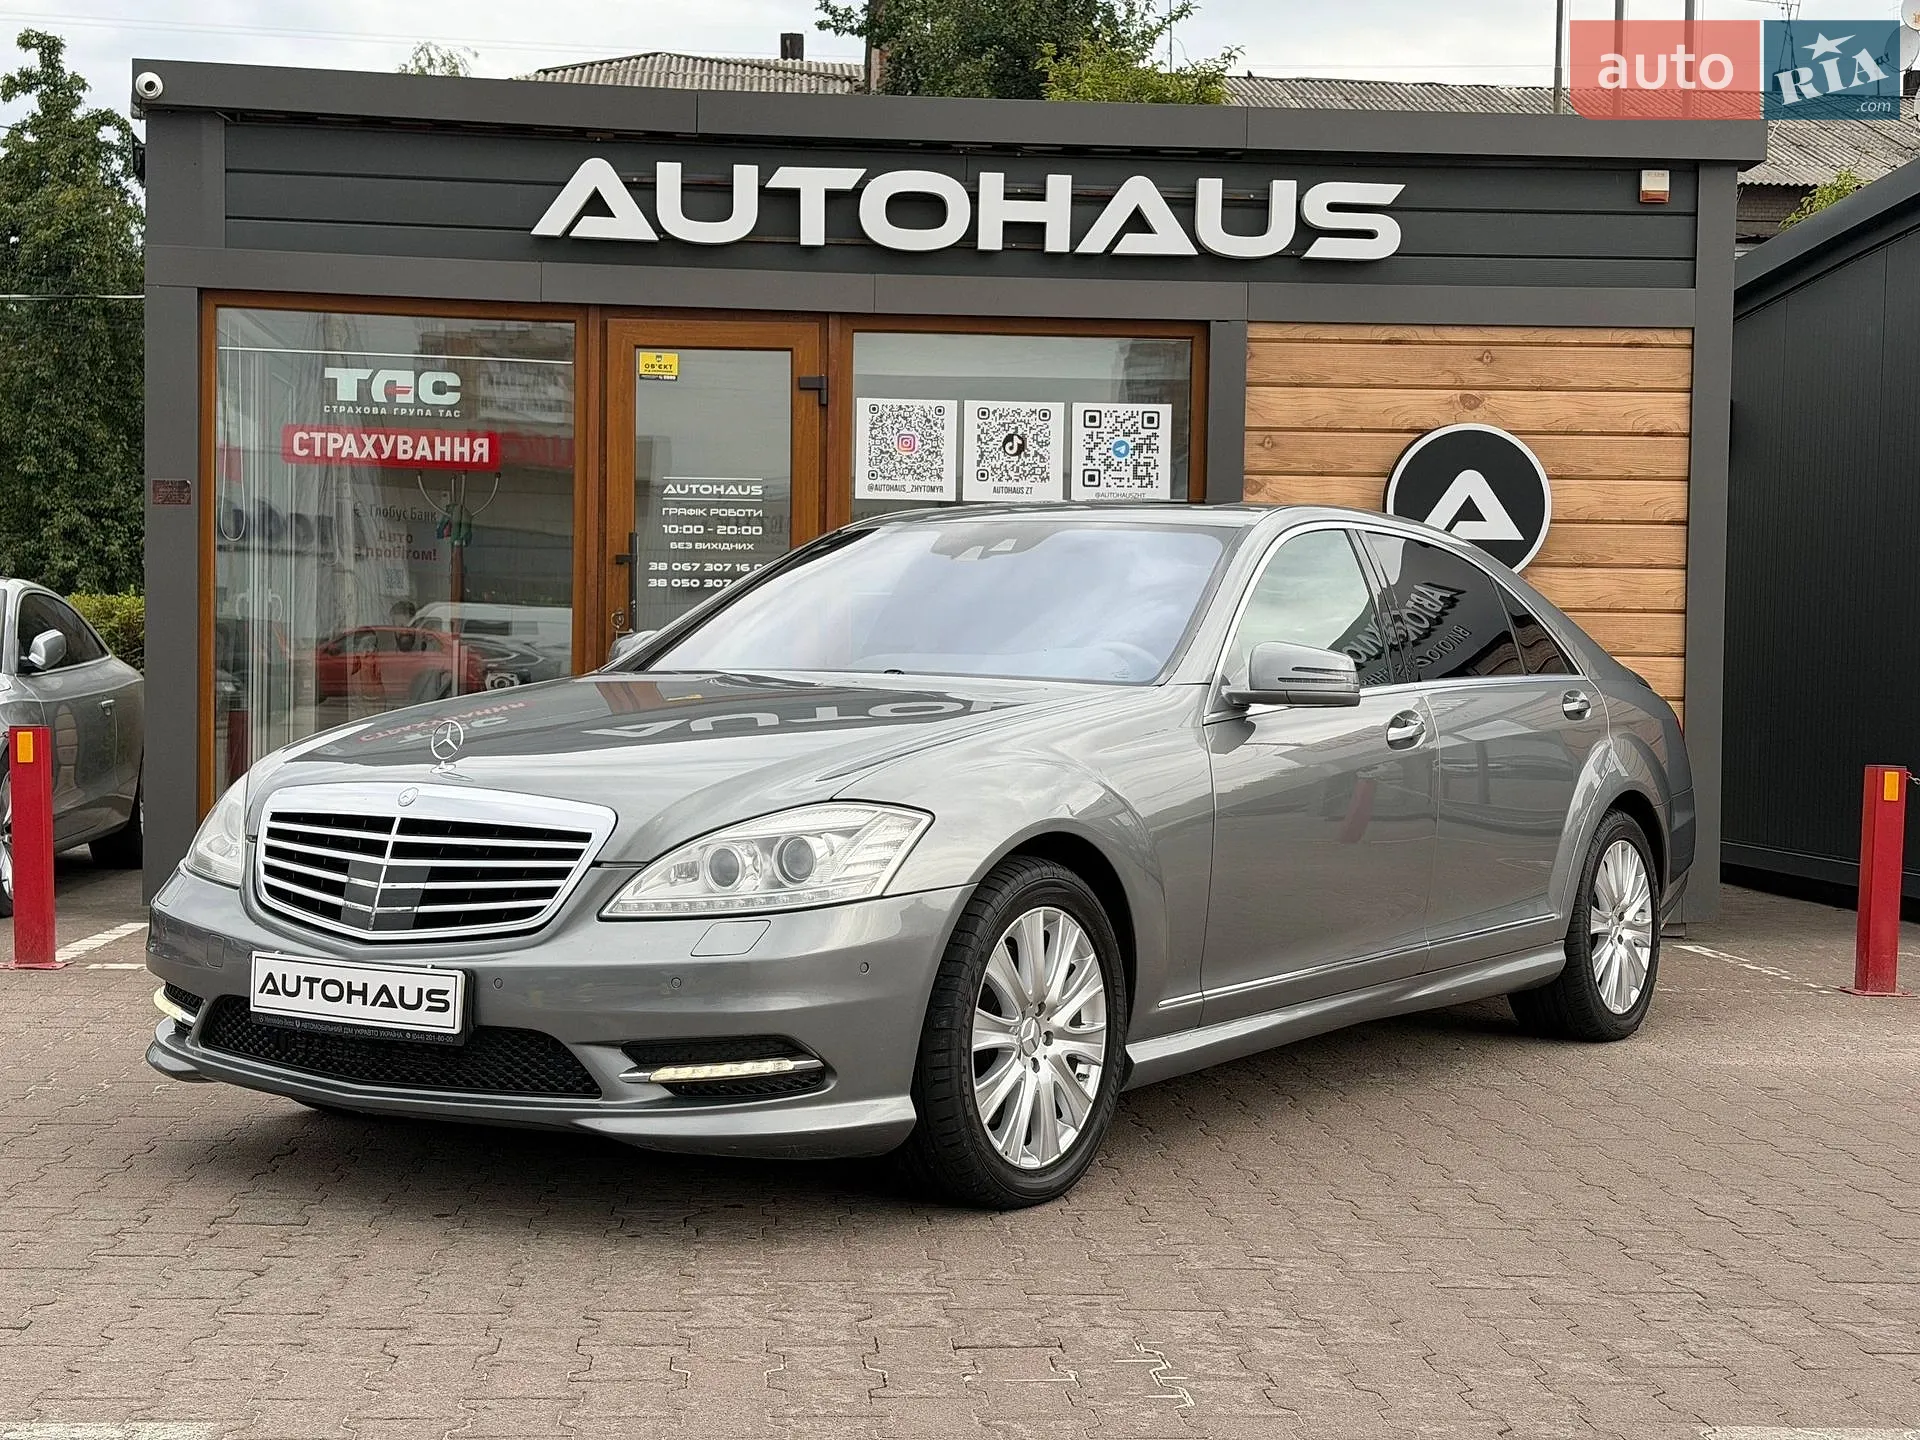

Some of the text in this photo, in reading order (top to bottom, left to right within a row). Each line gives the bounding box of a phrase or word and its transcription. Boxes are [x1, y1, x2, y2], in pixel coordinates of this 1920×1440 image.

[530, 157, 1406, 261] AUTOHAUS
[324, 368, 461, 405] ТАС
[324, 405, 461, 418] СТРАХОВА ГРУПА ТАС
[293, 431, 490, 463] СТРАХУВАННЯ
[663, 483, 763, 496] AUTOHAUS
[867, 483, 944, 494] @AUTOHAUS_ZHYTOMYR
[992, 486, 1033, 495] AUTOHAUS ZT
[370, 504, 437, 523] Глобус Банк
[662, 507, 763, 518] ГРАФІК РОБОТИ
[662, 525, 704, 535] 10:00
[716, 525, 763, 535] 20:00
[670, 542, 755, 552] БЕЗ ВИХІДНИХ
[366, 546, 437, 561] пробігом!
[648, 562, 668, 571] 38
[672, 562, 701, 571] 067
[704, 563, 732, 572] 307
[736, 563, 750, 572] 16
[648, 578, 732, 588] 38 050 307
[258, 971, 450, 1013] AUTOHAUS
[354, 1028, 379, 1037] УКРАВТО
[379, 1030, 403, 1039] УКРАЇНА
